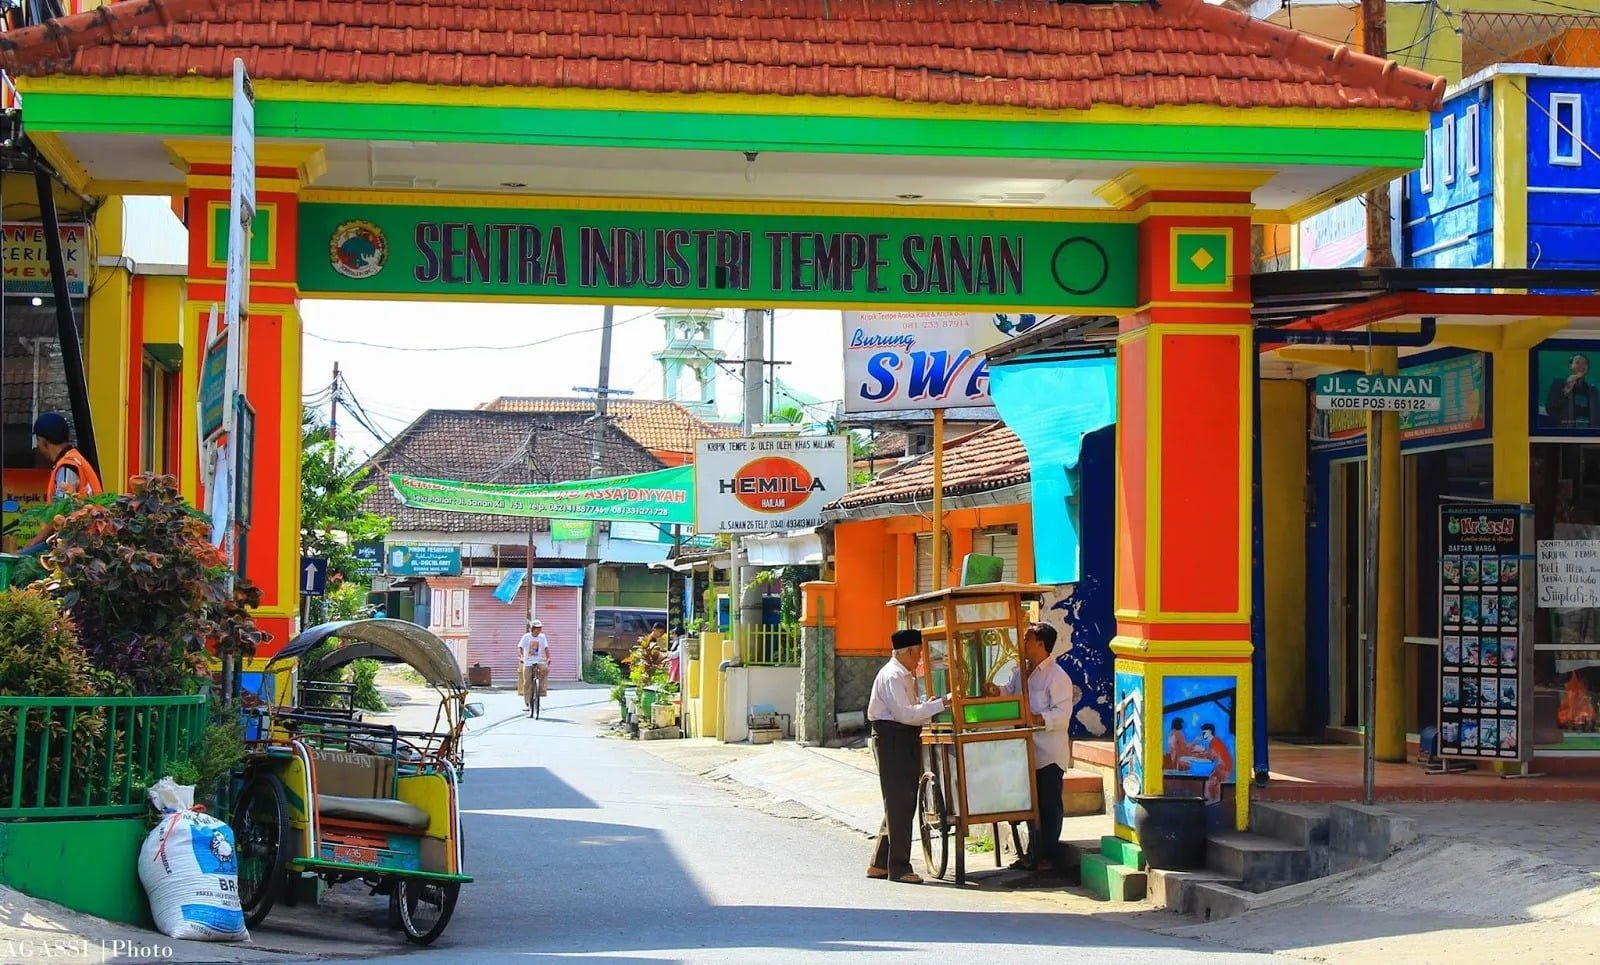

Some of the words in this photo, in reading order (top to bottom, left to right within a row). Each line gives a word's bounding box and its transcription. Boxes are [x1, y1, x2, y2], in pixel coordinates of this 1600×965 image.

[2, 228, 77, 243] NEA
[3, 247, 77, 261] ERIK
[415, 221, 567, 287] SENTRA
[579, 226, 752, 290] INDUSTRI
[765, 231, 890, 294] TEMPE
[901, 234, 1024, 296] SANAN
[850, 328, 916, 351] Burung
[1323, 378, 1352, 393] JL.
[1356, 378, 1433, 394] SANAN
[1330, 397, 1360, 408] KODE
[1362, 398, 1386, 409] POS
[1394, 399, 1426, 410] 65122
[707, 442, 726, 451] KRIPIK
[728, 442, 748, 451] TEMPE
[750, 442, 756, 451] &
[758, 441, 774, 450] OLEH
[776, 441, 792, 450] OLEH
[795, 440, 811, 449] KHAS
[813, 439, 836, 449] MALANG
[719, 477, 826, 494] HEMILA
[728, 520, 747, 530] SANAN
[806, 518, 825, 528] MALA
